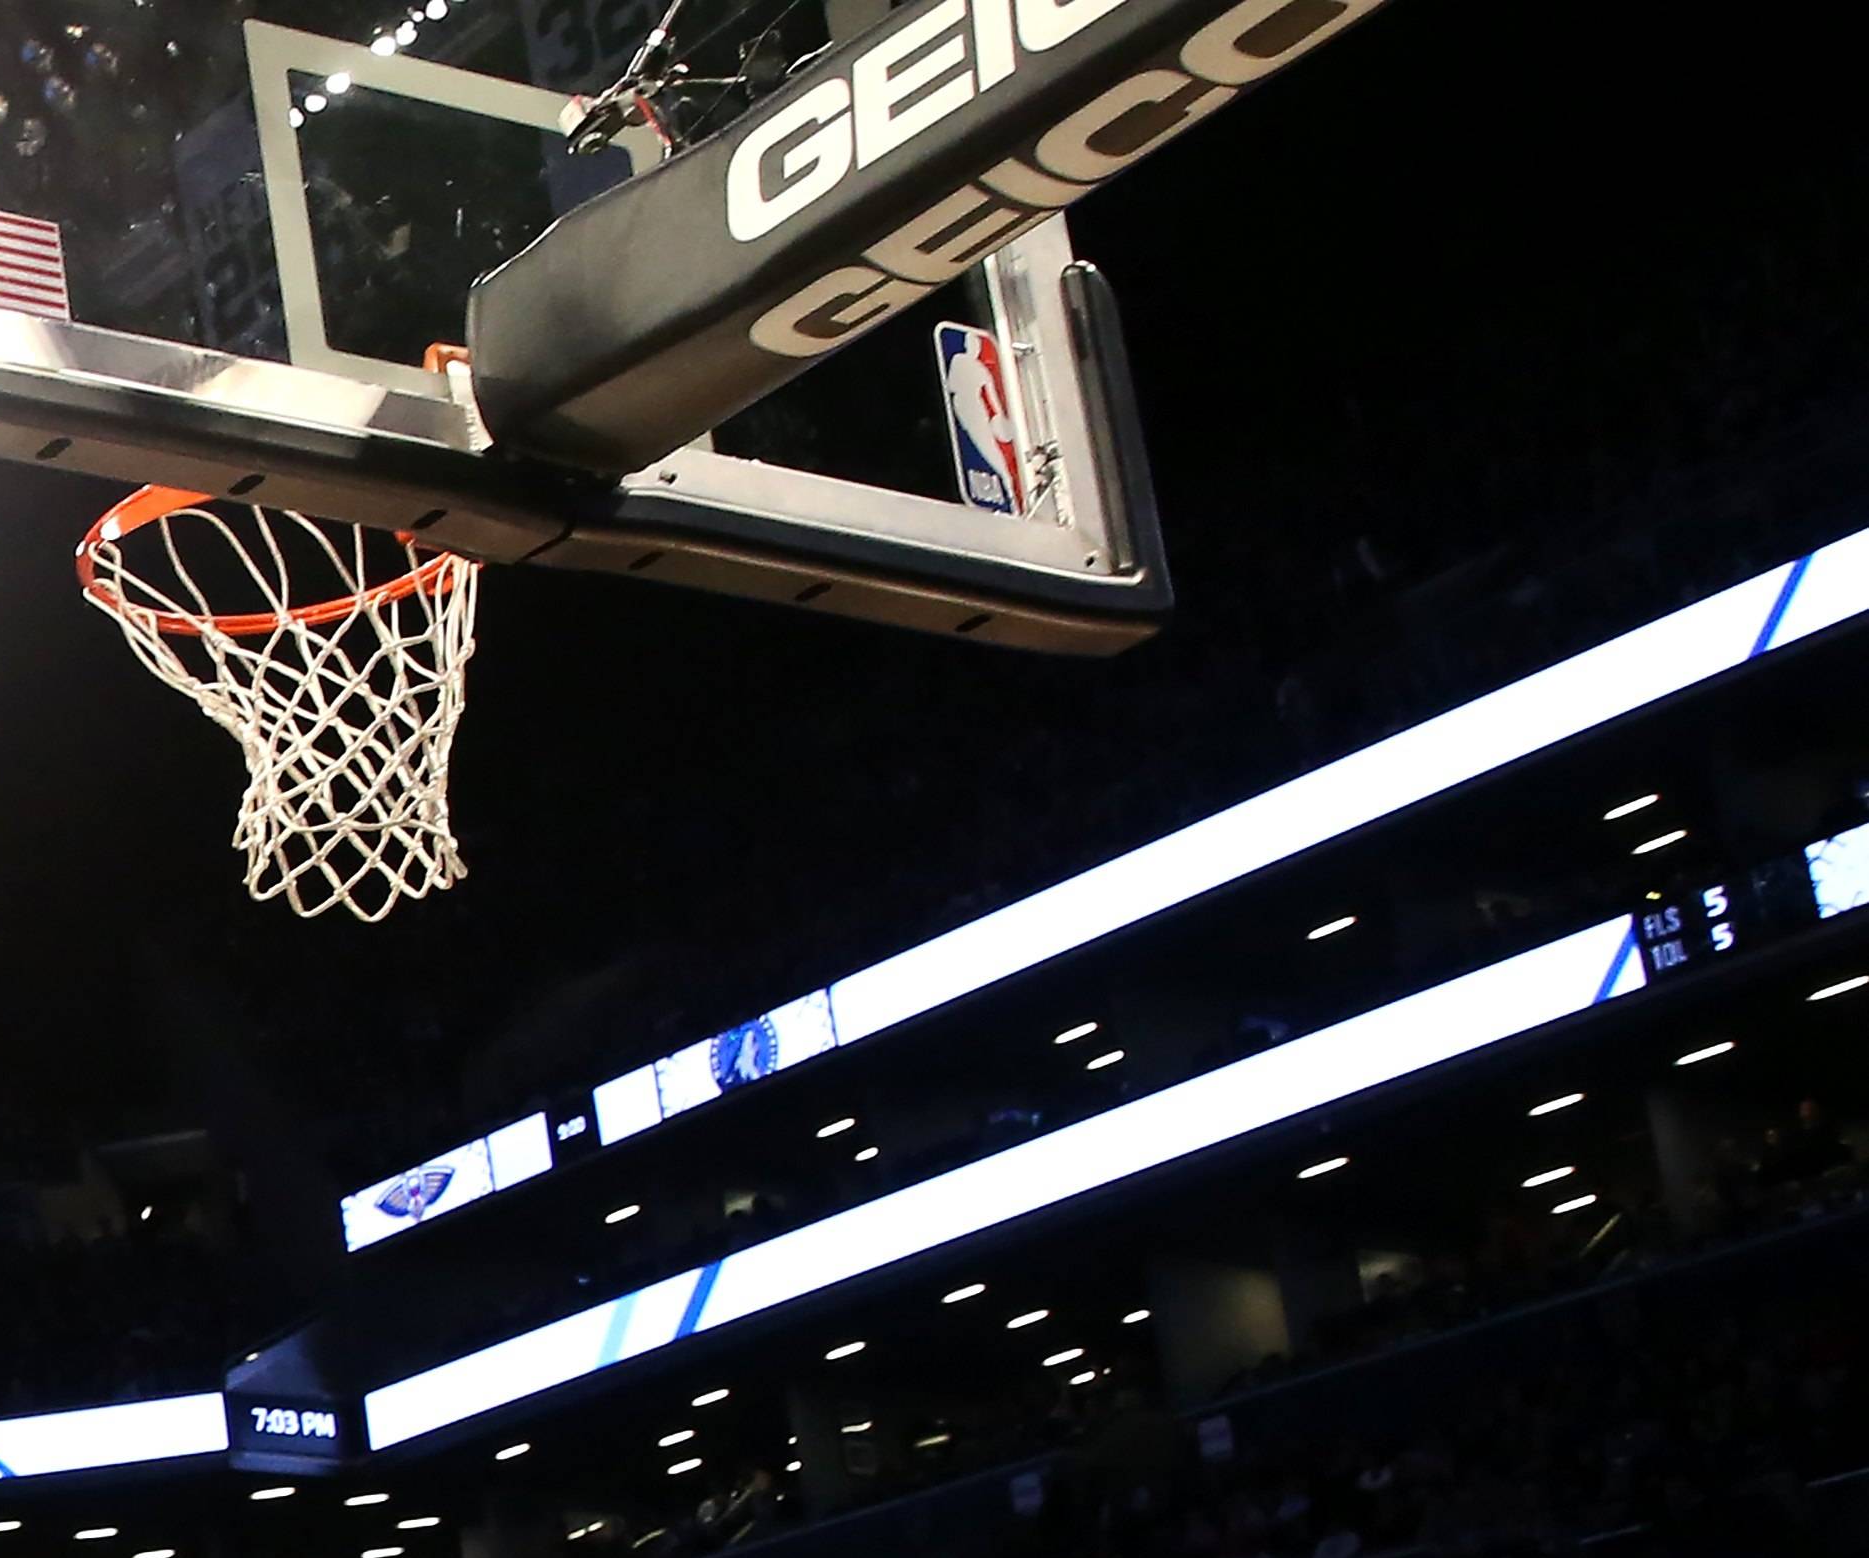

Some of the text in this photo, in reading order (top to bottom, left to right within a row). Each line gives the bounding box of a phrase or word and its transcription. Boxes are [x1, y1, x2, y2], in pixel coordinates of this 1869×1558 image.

[1703, 885, 1728, 917] 5
[1712, 922, 1734, 951] 5
[251, 1407, 336, 1438] 7:03 PM
